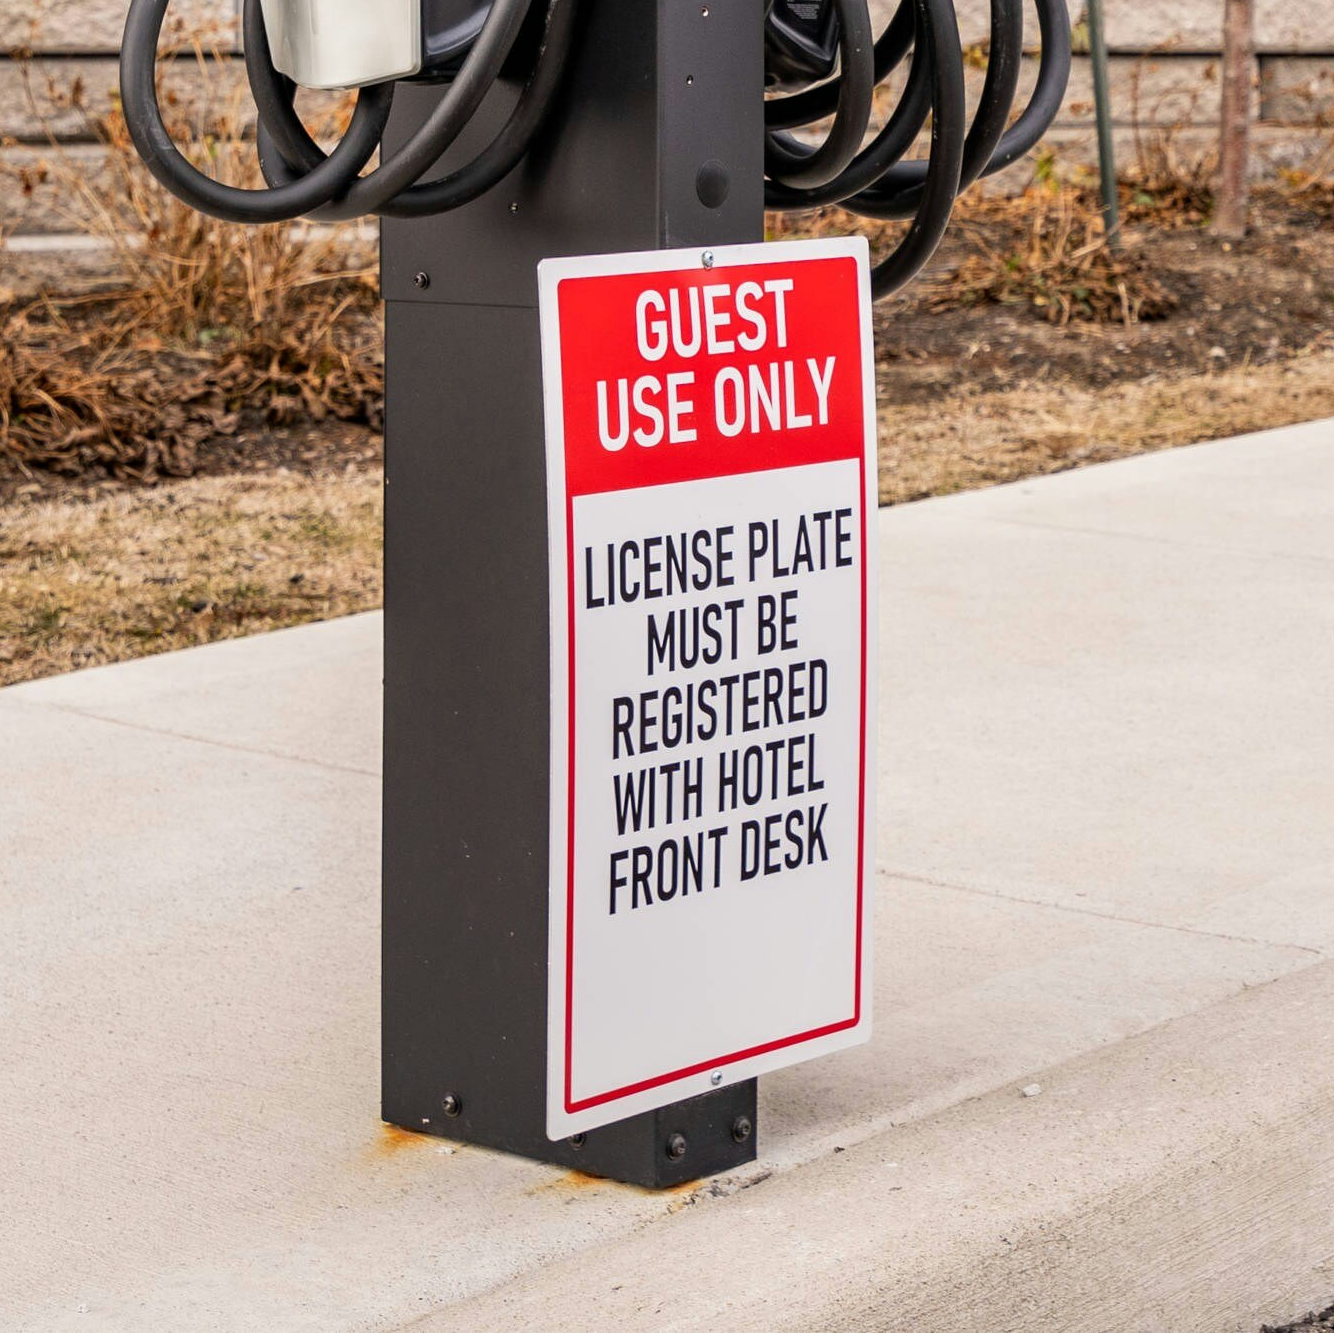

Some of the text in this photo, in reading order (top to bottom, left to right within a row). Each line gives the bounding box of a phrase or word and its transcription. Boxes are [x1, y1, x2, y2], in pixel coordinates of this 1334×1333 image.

[635, 278, 794, 361] GUEST
[596, 356, 836, 452] USE ONLY
[585, 507, 853, 610] LICENSE PLATE
[647, 589, 798, 676] MUST BE
[612, 658, 828, 760] REGISTERED
[613, 733, 825, 836] WITH HOTEL
[609, 802, 829, 916] FRONT DESK
